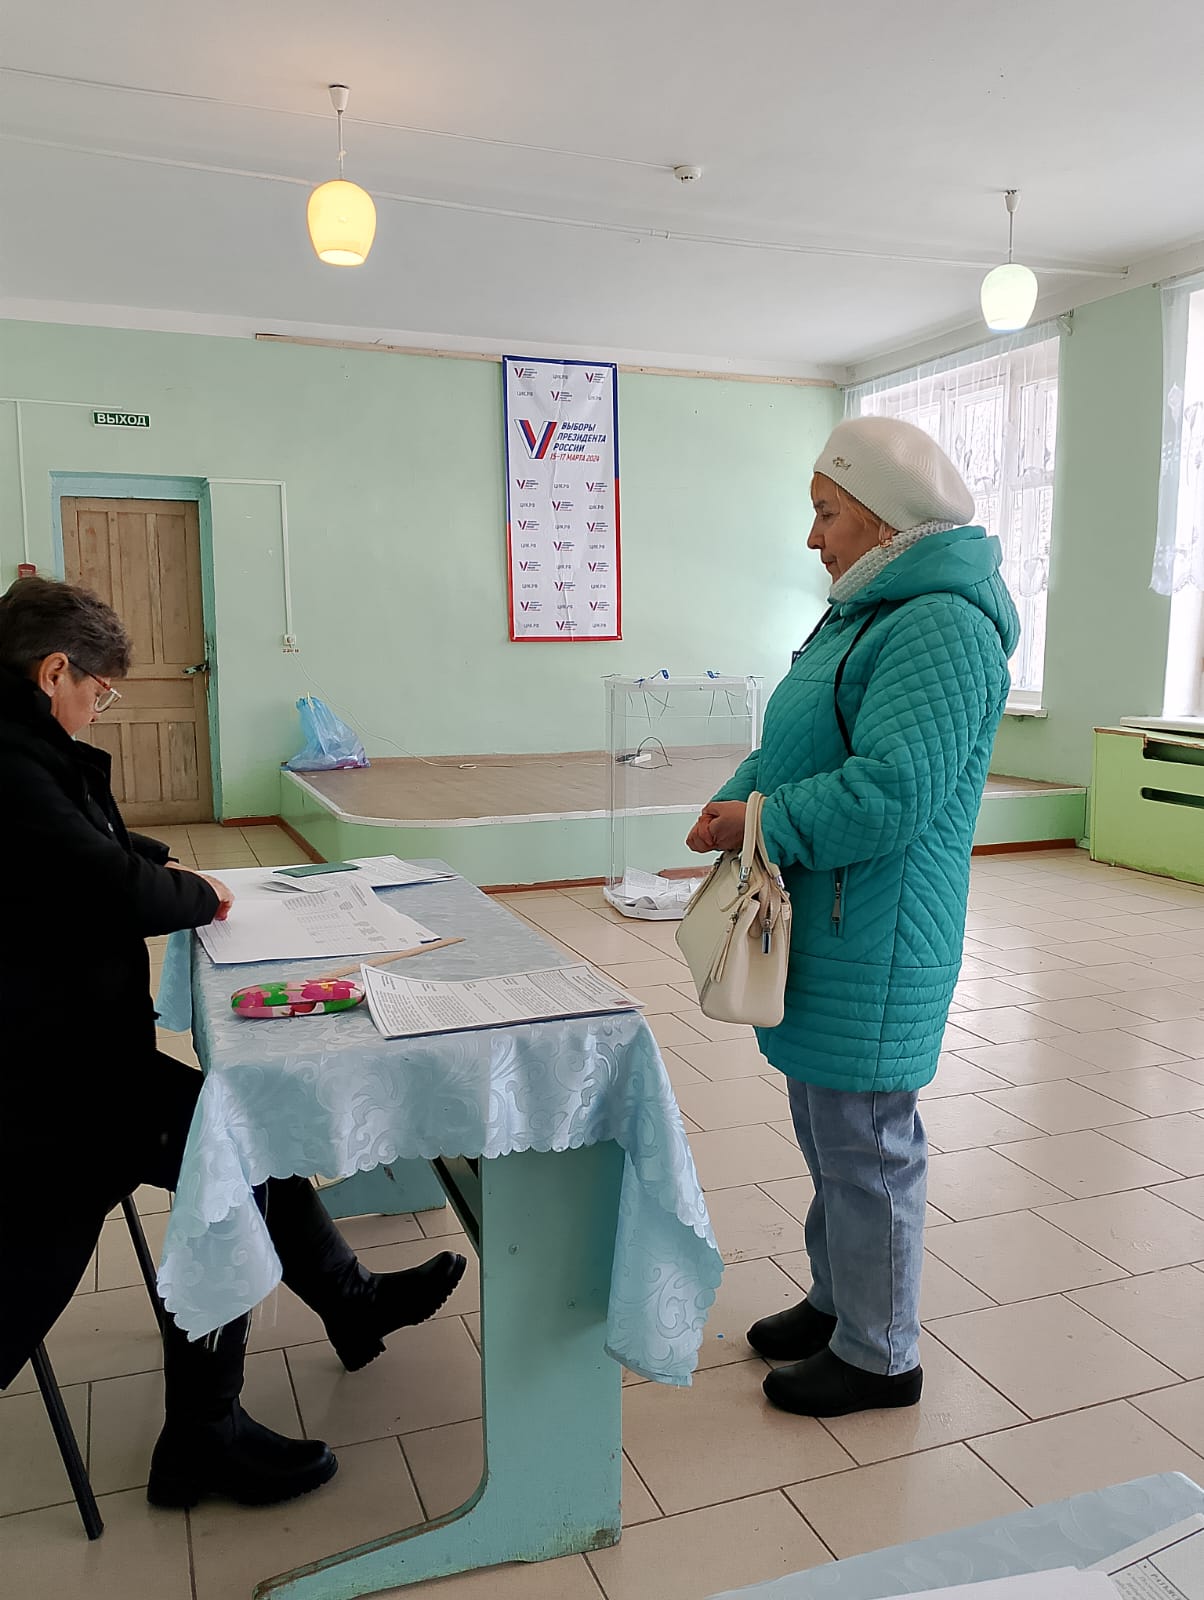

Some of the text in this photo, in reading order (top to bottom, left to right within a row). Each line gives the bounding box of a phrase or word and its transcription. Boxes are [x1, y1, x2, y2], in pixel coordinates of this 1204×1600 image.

[97, 413, 147, 426] ВЫХОД
[561, 422, 596, 432] ВЫБОРЫ
[557, 432, 606, 443] ПРЕЗИДЕНТА
[553, 442, 586, 452] РОССИИ
[567, 453, 586, 461] МАРТА
[586, 454, 600, 462] 2024
